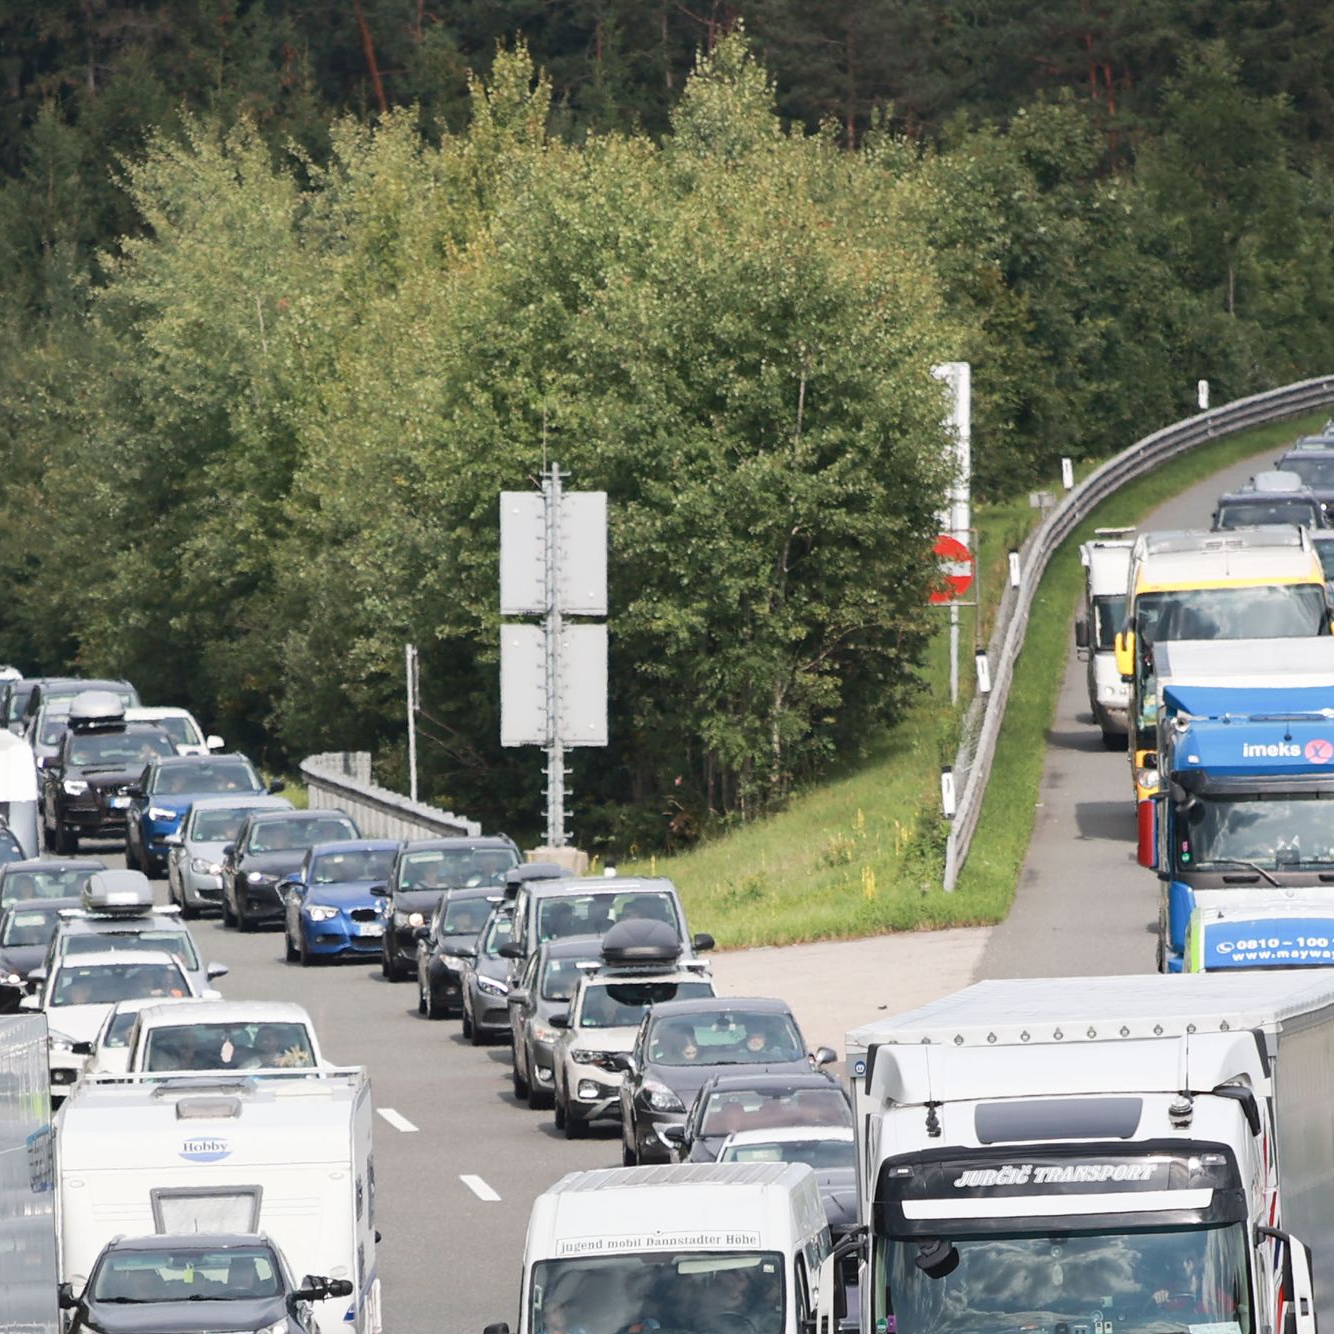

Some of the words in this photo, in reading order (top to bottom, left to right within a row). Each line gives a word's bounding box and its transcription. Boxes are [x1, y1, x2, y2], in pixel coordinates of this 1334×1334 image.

[1243, 742, 1301, 758] imeks
[1236, 938, 1280, 950] 0810
[1297, 937, 1328, 948] 100
[183, 1141, 228, 1153] Hobby
[1033, 1163, 1157, 1184] TRANSPORT
[561, 1239, 603, 1254] jugend
[608, 1238, 641, 1249] mobil
[726, 1233, 757, 1245] Höhe
